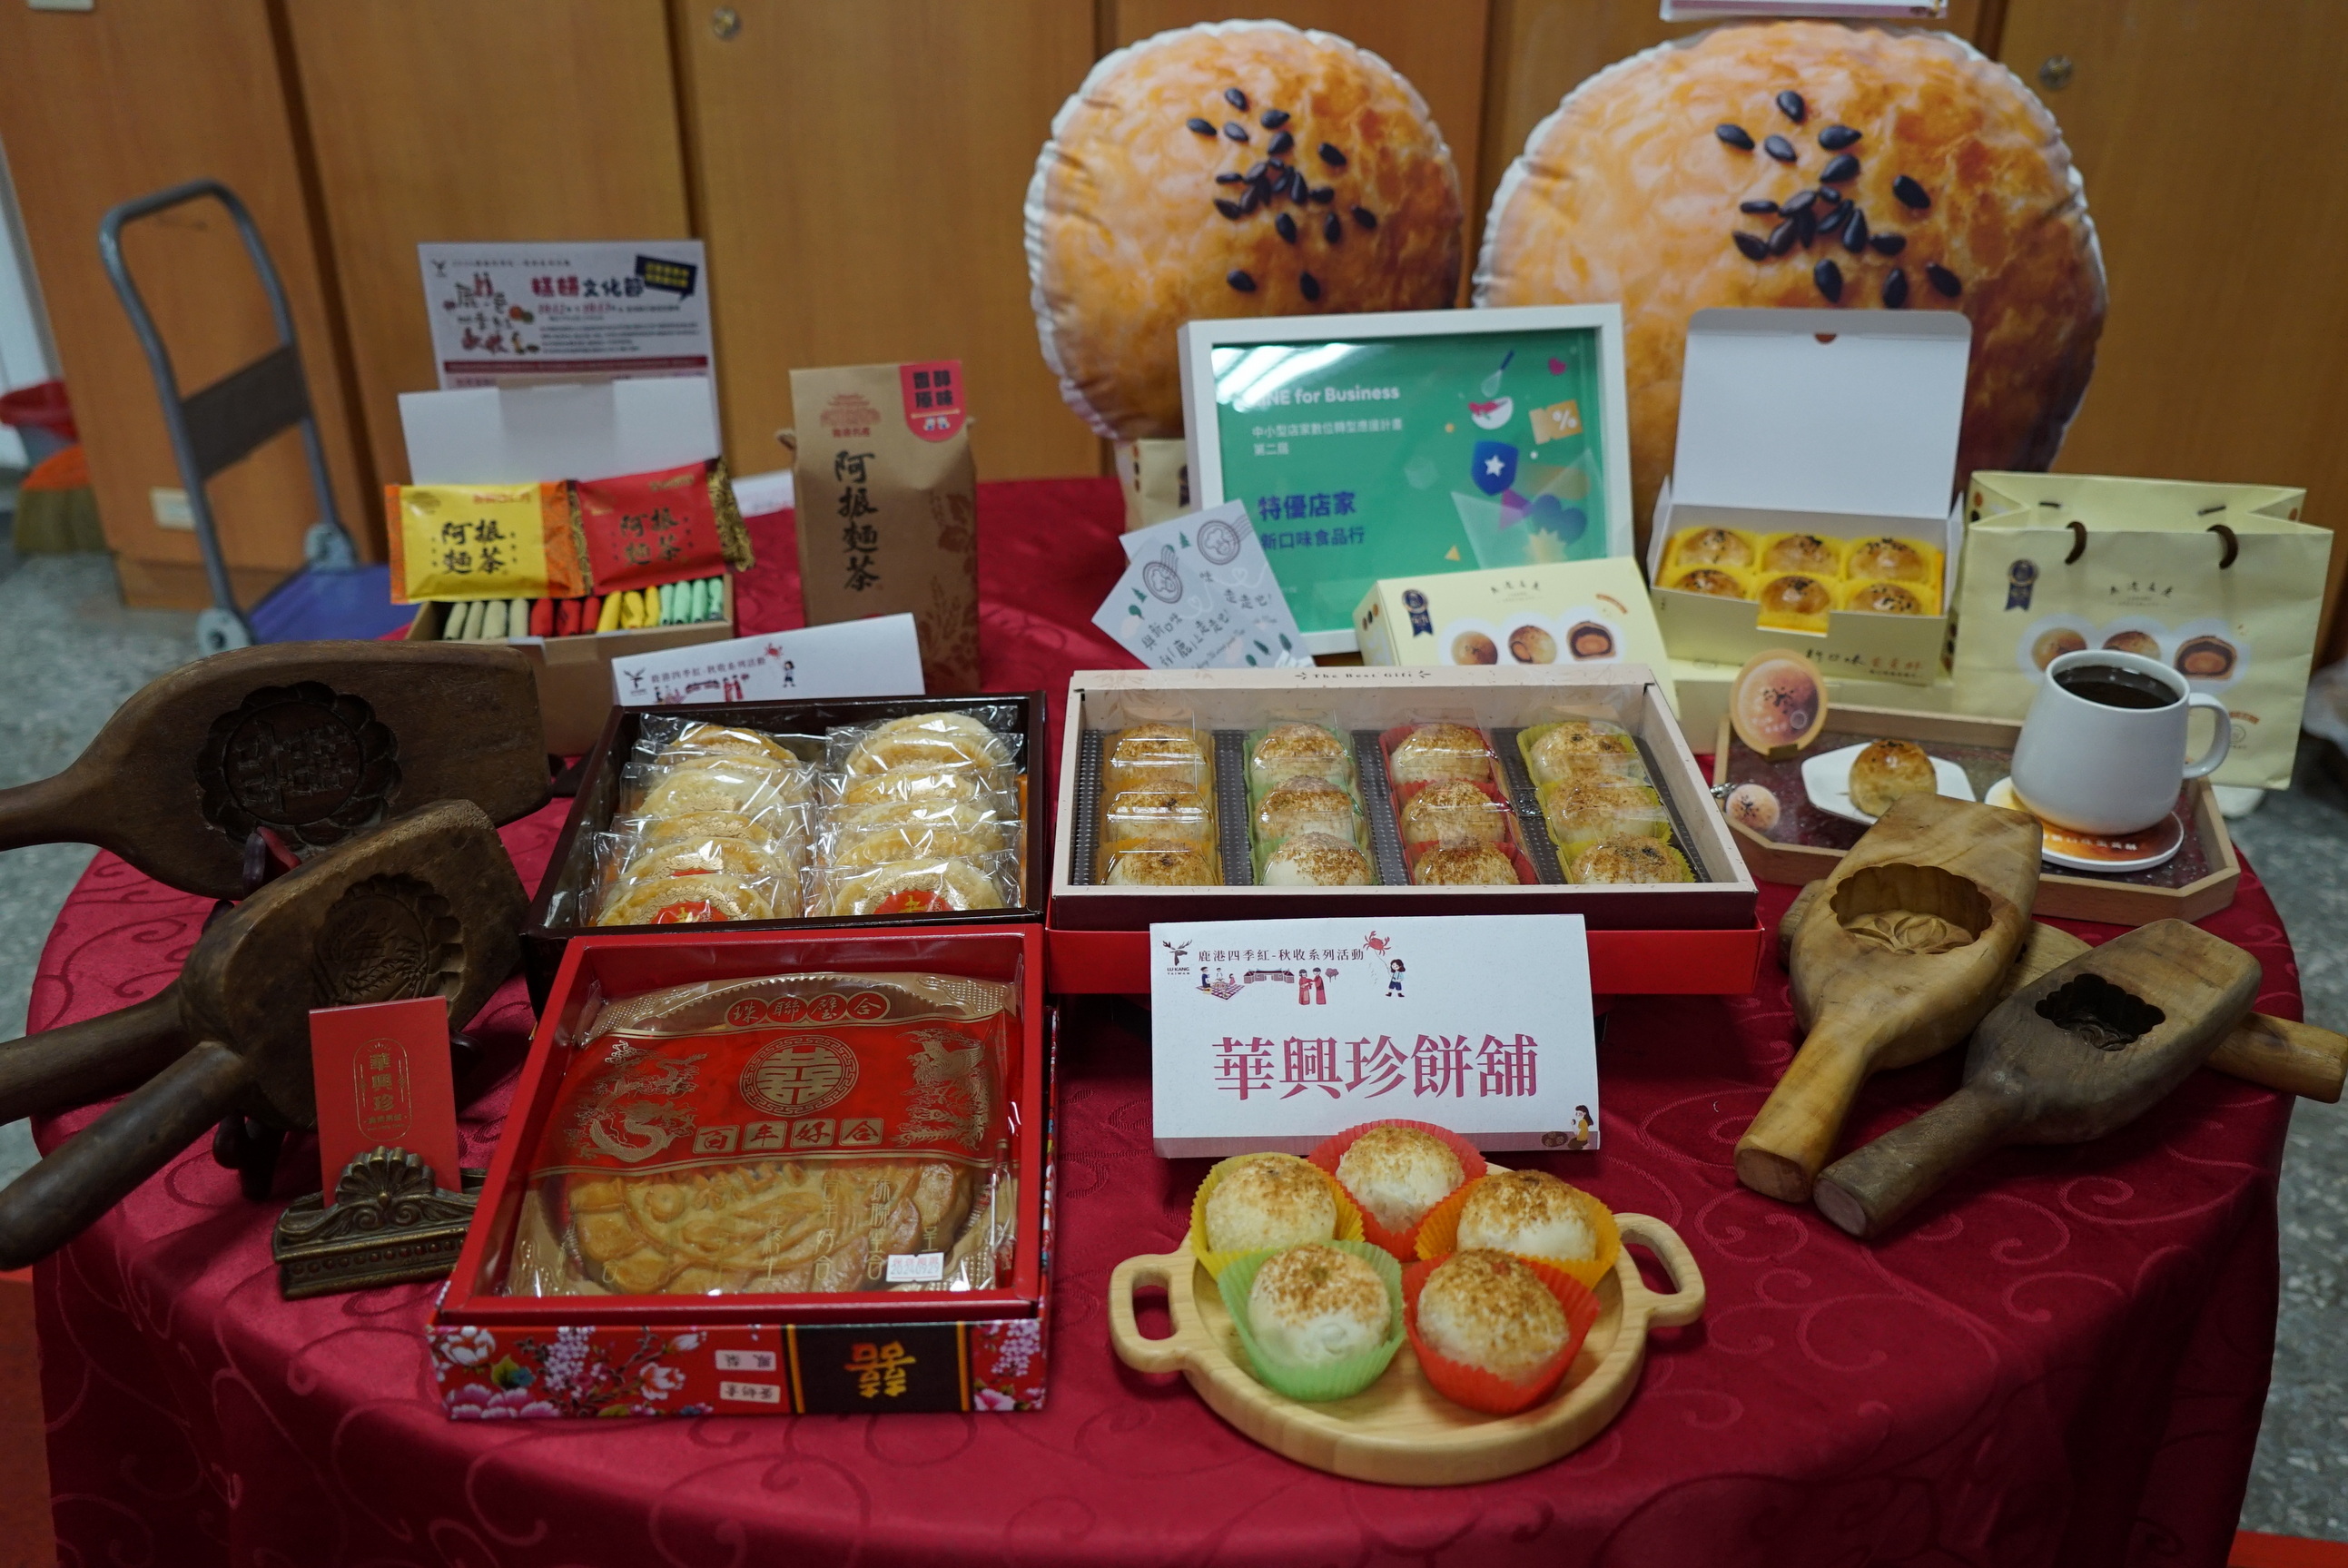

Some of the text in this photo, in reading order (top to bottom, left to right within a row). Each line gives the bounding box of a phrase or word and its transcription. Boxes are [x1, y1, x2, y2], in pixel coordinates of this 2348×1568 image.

[1253, 384, 1400, 408] INE for Business
[1258, 491, 1356, 521] 特優店家
[1261, 527, 1365, 551] 新口味食品行
[1198, 949, 1365, 962] 鹿港四季紅-秋收系列活動
[1212, 1033, 1538, 1101] 華興珍餅舖
[700, 1120, 882, 1151] 百年好合
